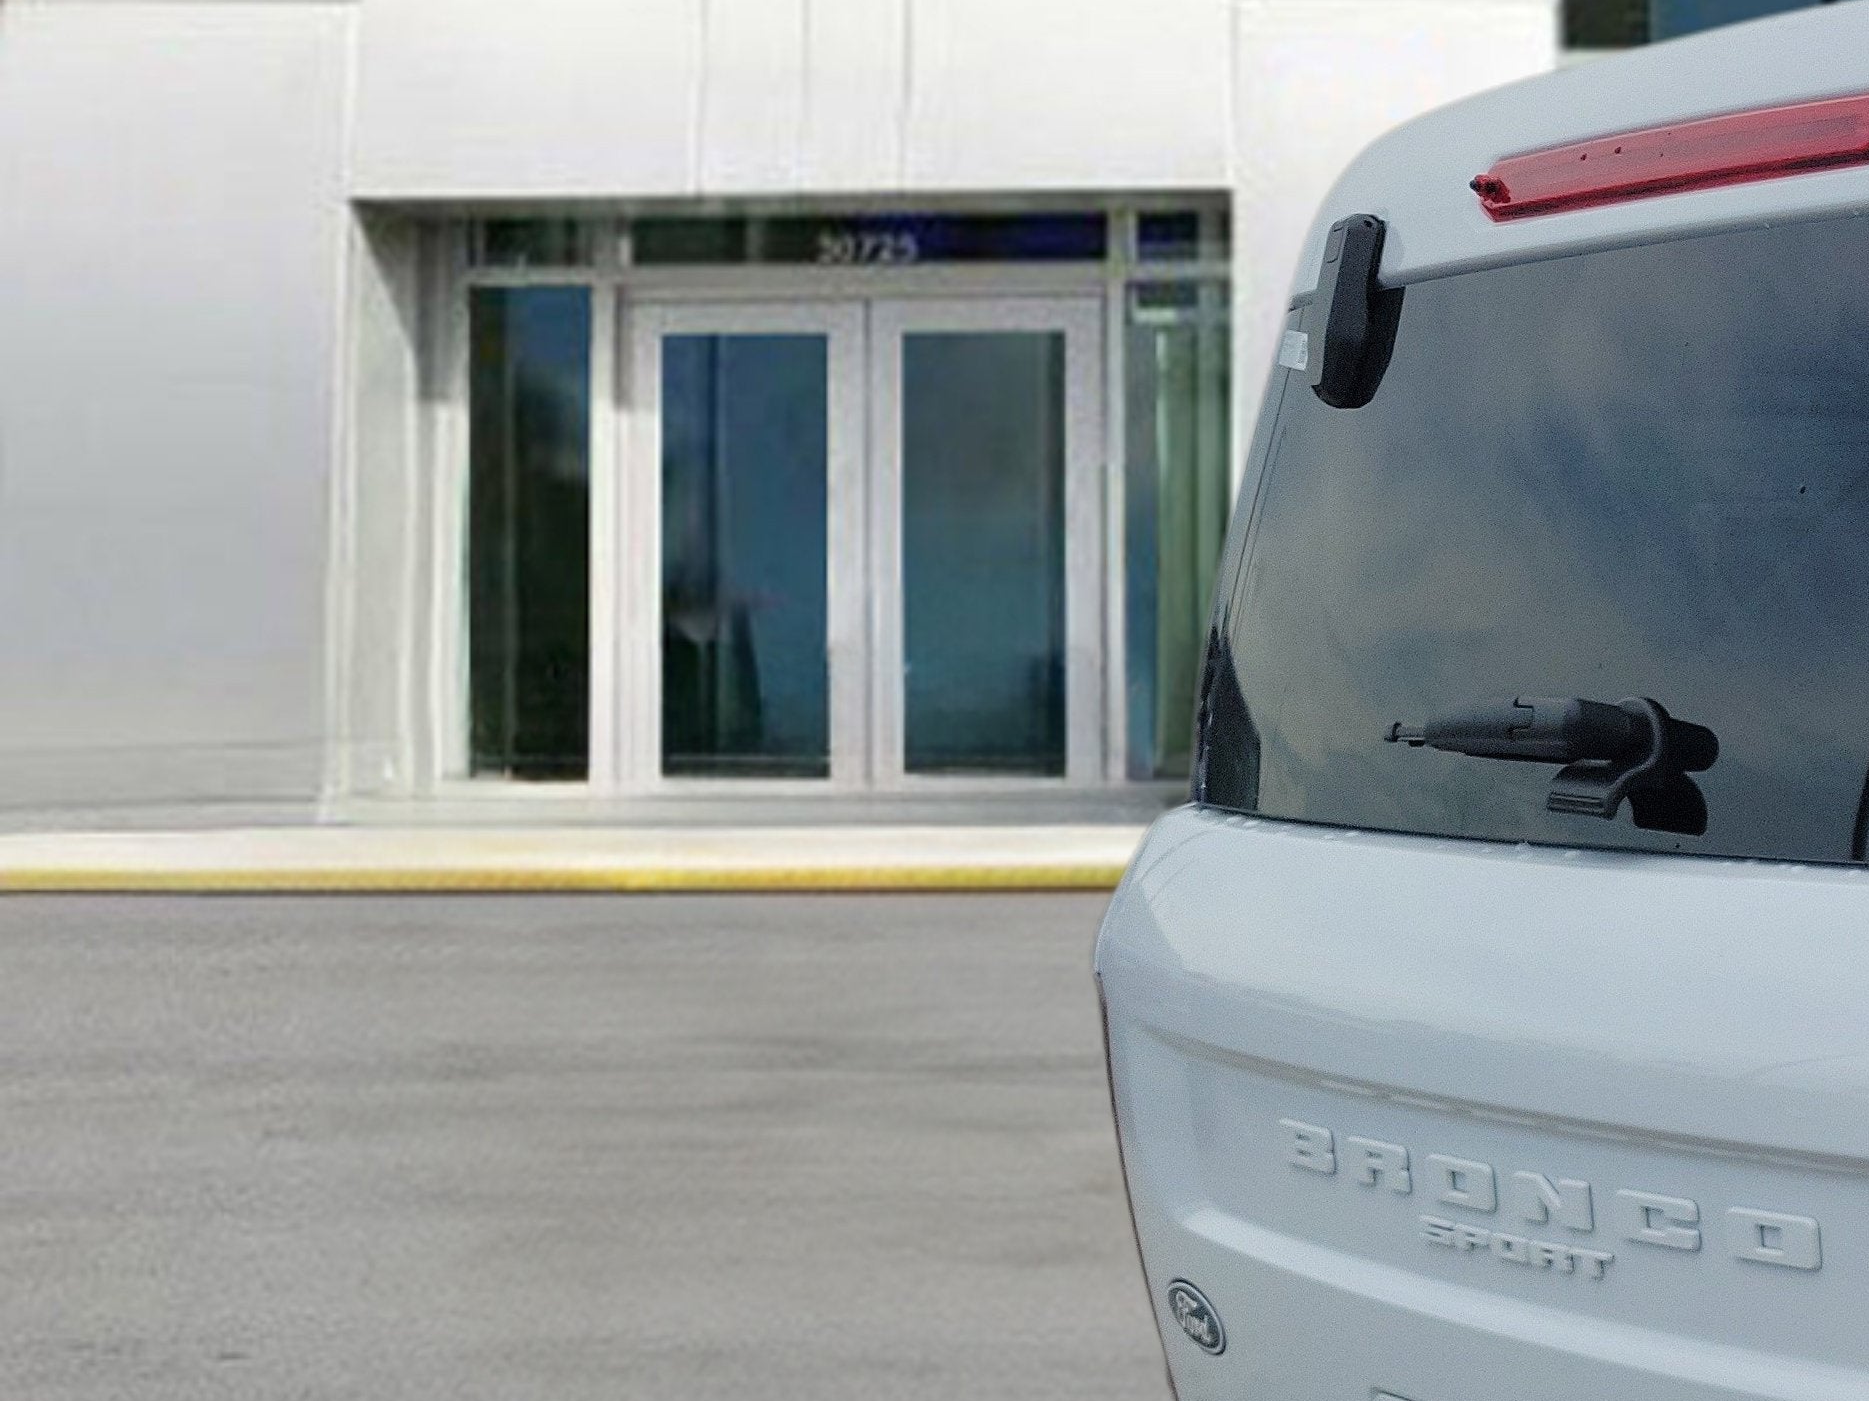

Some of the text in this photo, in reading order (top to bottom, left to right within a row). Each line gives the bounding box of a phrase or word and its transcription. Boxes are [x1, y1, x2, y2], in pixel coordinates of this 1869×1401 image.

[1278, 1117, 1823, 1271] BRONCO
[1418, 1214, 1615, 1281] SPORT
[1175, 1289, 1213, 1344] Ford
